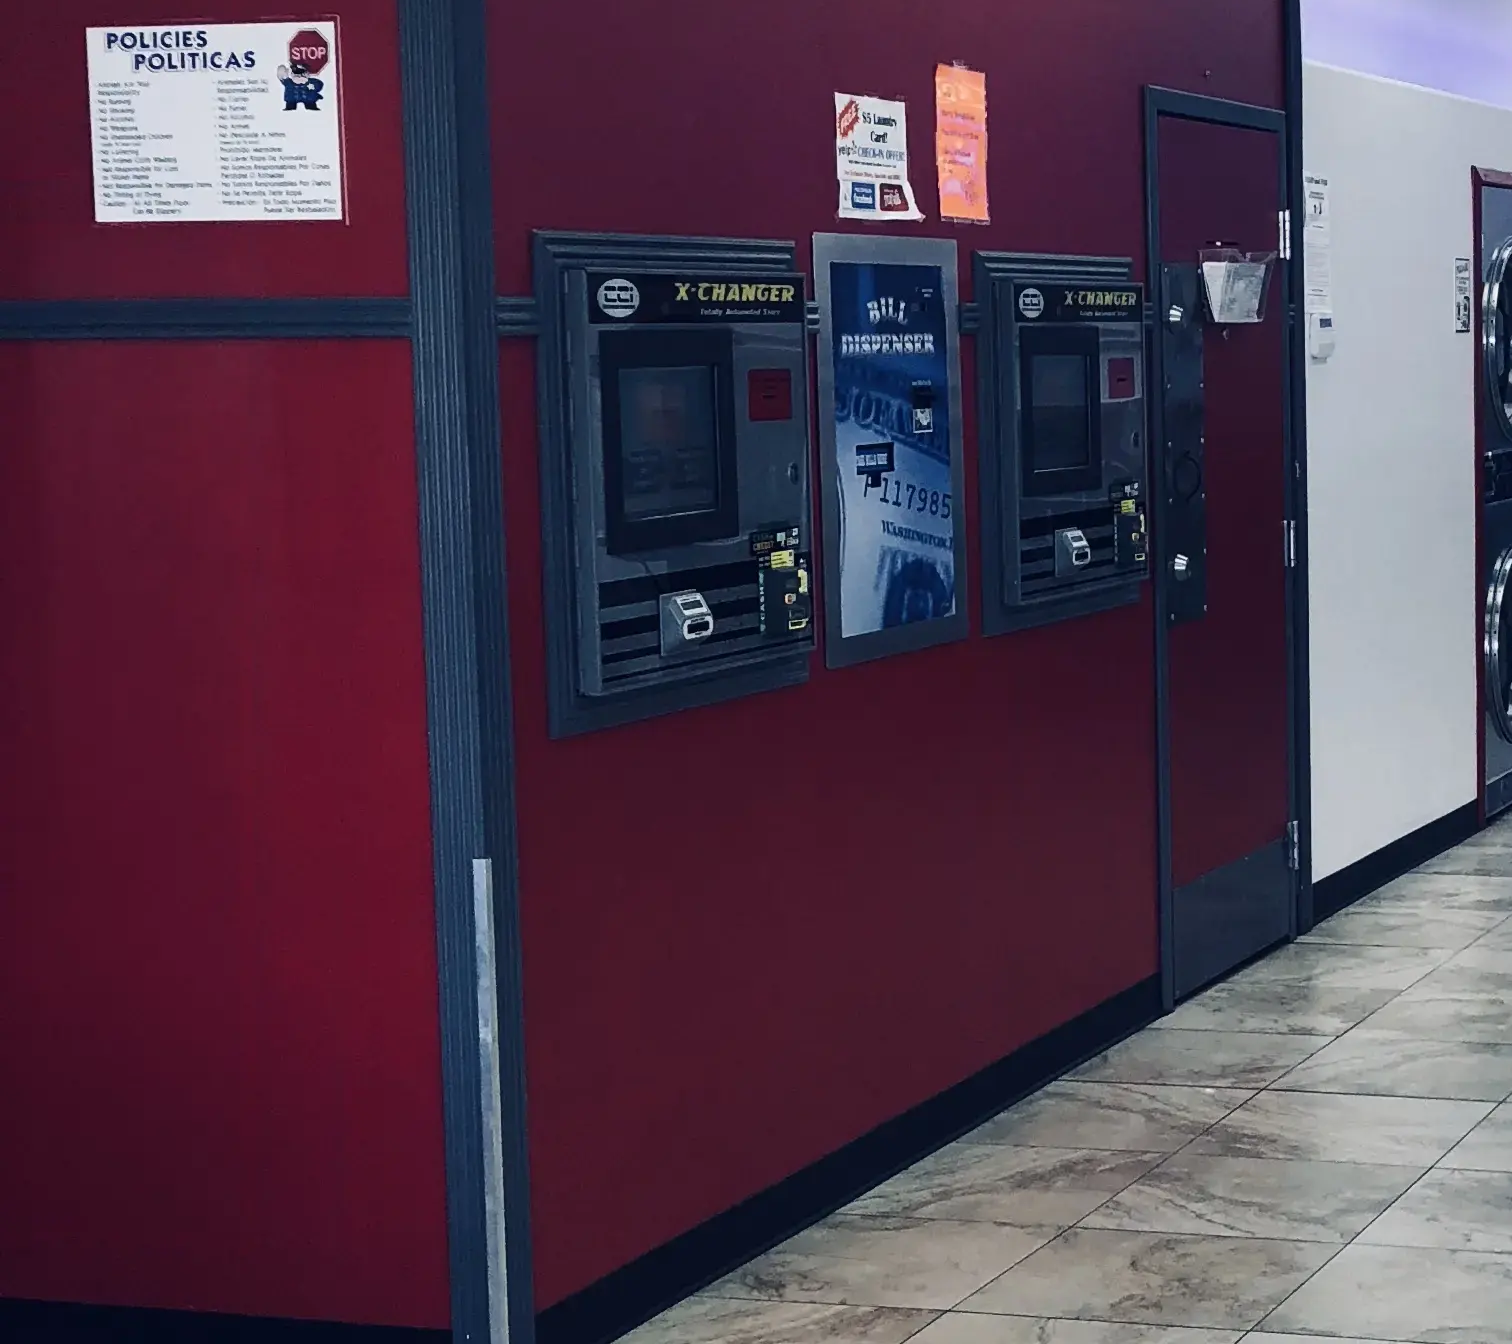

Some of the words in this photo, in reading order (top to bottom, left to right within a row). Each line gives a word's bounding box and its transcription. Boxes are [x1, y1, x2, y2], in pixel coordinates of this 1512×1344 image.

[106, 30, 208, 50] POLICIES
[134, 51, 256, 71] POLITICAS
[291, 47, 327, 61] STOP
[866, 296, 908, 325] BILL
[841, 332, 935, 357] DISPENSER
